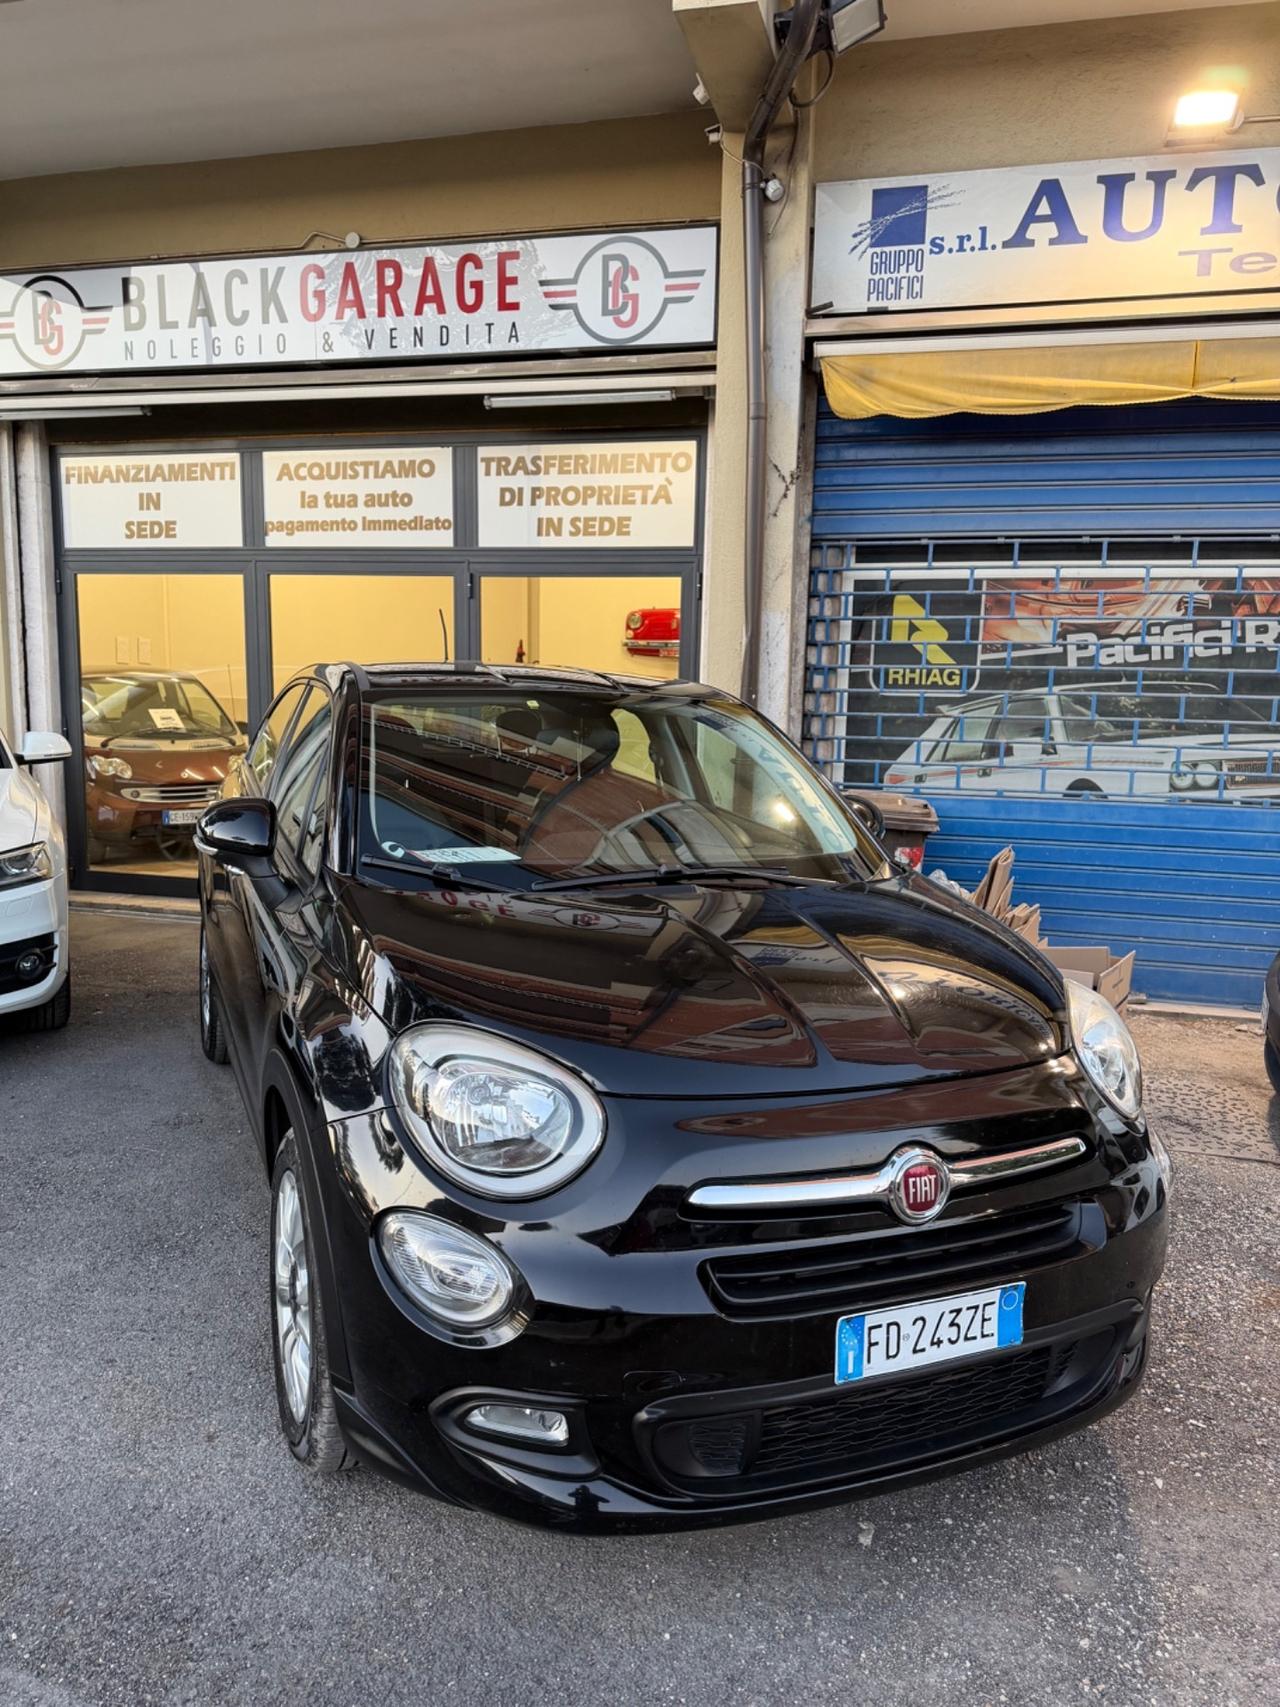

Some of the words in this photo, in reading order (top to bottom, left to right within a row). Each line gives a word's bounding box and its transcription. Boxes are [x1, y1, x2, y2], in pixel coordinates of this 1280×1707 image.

[929, 226, 997, 255] s.r.l.
[1001, 163, 1280, 250] AUT
[870, 248, 925, 276] GRUPPO
[867, 275, 924, 302] PACIFICI
[124, 333, 286, 361] NOLEGGIO
[322, 331, 334, 353] &
[365, 321, 520, 350] VENDITA
[65, 461, 236, 485] FINANZIAMENTI
[276, 459, 436, 482] ACQUISTIAMO
[480, 451, 693, 477] TRASFERIMENTO
[138, 492, 161, 511] IN
[300, 490, 318, 508] la
[324, 491, 358, 508] tua
[364, 490, 413, 507] auto
[499, 487, 524, 507] DI
[530, 477, 673, 507] PROPRIETÀ
[124, 520, 177, 540] SEDE
[265, 517, 358, 537] pagamento
[537, 517, 563, 537] IN
[569, 516, 632, 537] SEDE
[1067, 619, 1233, 667] Pacifici
[888, 668, 961, 686] RHIAG
[908, 1174, 937, 1204] FIAT
